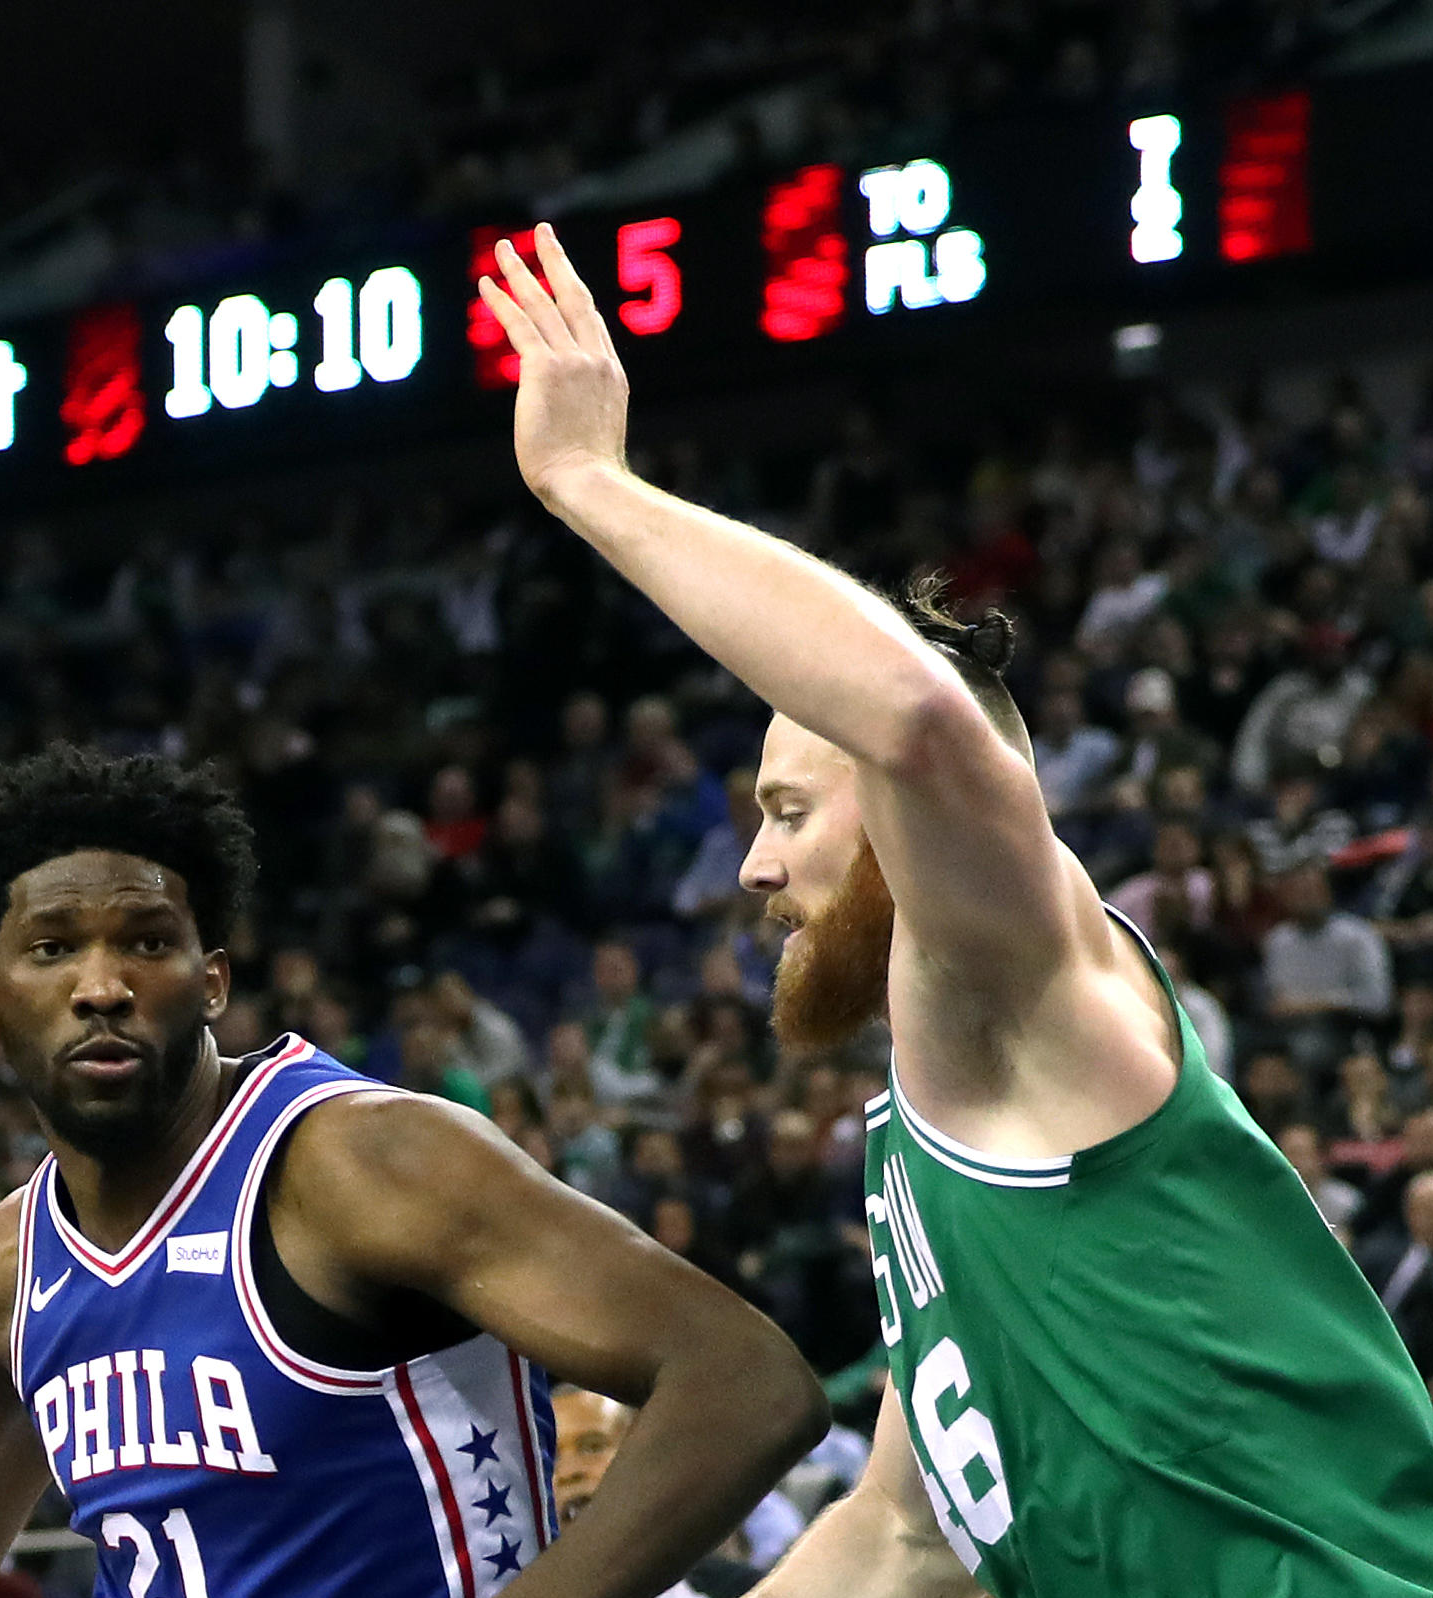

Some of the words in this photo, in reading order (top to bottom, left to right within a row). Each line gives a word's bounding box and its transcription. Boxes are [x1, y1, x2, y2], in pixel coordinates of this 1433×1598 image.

[617, 217, 682, 335] 5
[165, 266, 422, 420] 10:10
[176, 1246, 219, 1261] StubHub
[34, 1348, 279, 1495] PHILA
